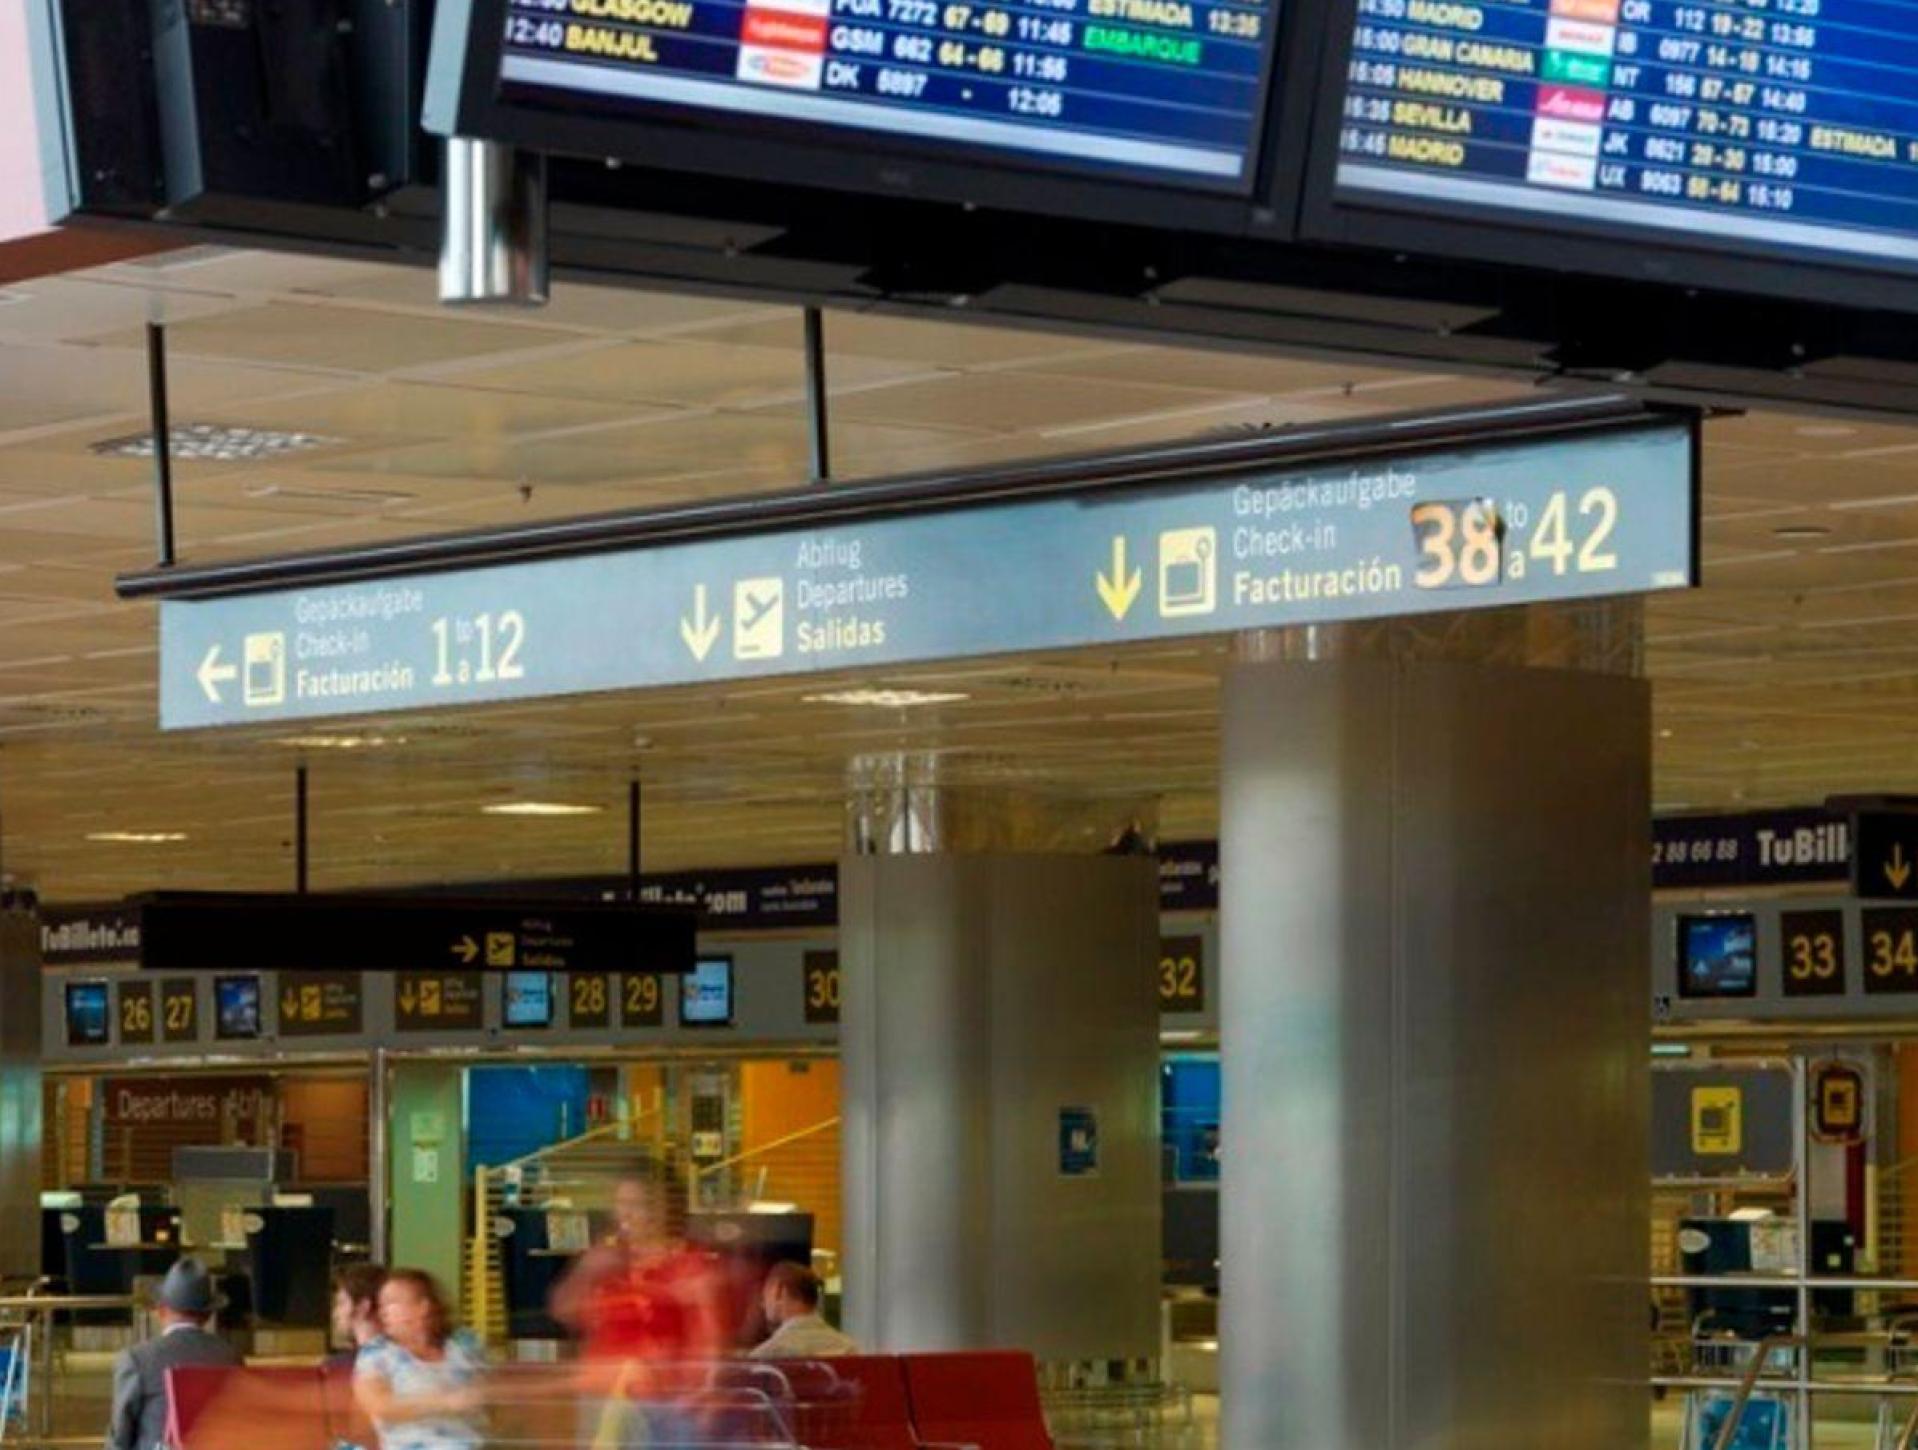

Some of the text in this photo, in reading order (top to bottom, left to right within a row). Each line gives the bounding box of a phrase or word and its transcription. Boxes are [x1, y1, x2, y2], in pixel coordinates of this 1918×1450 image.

[505, 17, 658, 62] 12:40 BANJUL
[829, 27, 885, 55] GSM
[1082, 24, 1202, 64] EMBARQUE
[1400, 34, 1453, 58] GRAN
[1455, 41, 1535, 73] CANARIA
[826, 61, 860, 88] DK
[1397, 67, 1505, 103] HANNOVER
[1612, 64, 1641, 88] NT
[1388, 135, 1466, 167] MADRID
[1602, 131, 1630, 155] JK
[1392, 102, 1473, 133] SEVILLA
[1809, 125, 1898, 158] ESTIMADA
[1598, 164, 1626, 188] UX
[1233, 518, 1337, 559] Check-in
[1410, 486, 1618, 589] 38 to 42
[1233, 556, 1402, 606] Facturación
[1507, 550, 1526, 580] a
[797, 574, 910, 611] Departures
[296, 627, 371, 660] Check-in
[431, 616, 453, 687] 1
[474, 609, 526, 683] 12
[797, 616, 886, 653] Salidas
[297, 659, 414, 698] Facturación
[1755, 822, 1848, 867] TuBill
[1791, 934, 1836, 979] 33
[1871, 930, 1918, 977] 34
[573, 975, 606, 1014] 28
[626, 974, 659, 1014] 29
[809, 972, 839, 1008] 30
[1159, 956, 1197, 998] 32
[122, 998, 150, 1032] 26
[166, 995, 193, 1030] 27
[116, 1088, 217, 1125] Departures
